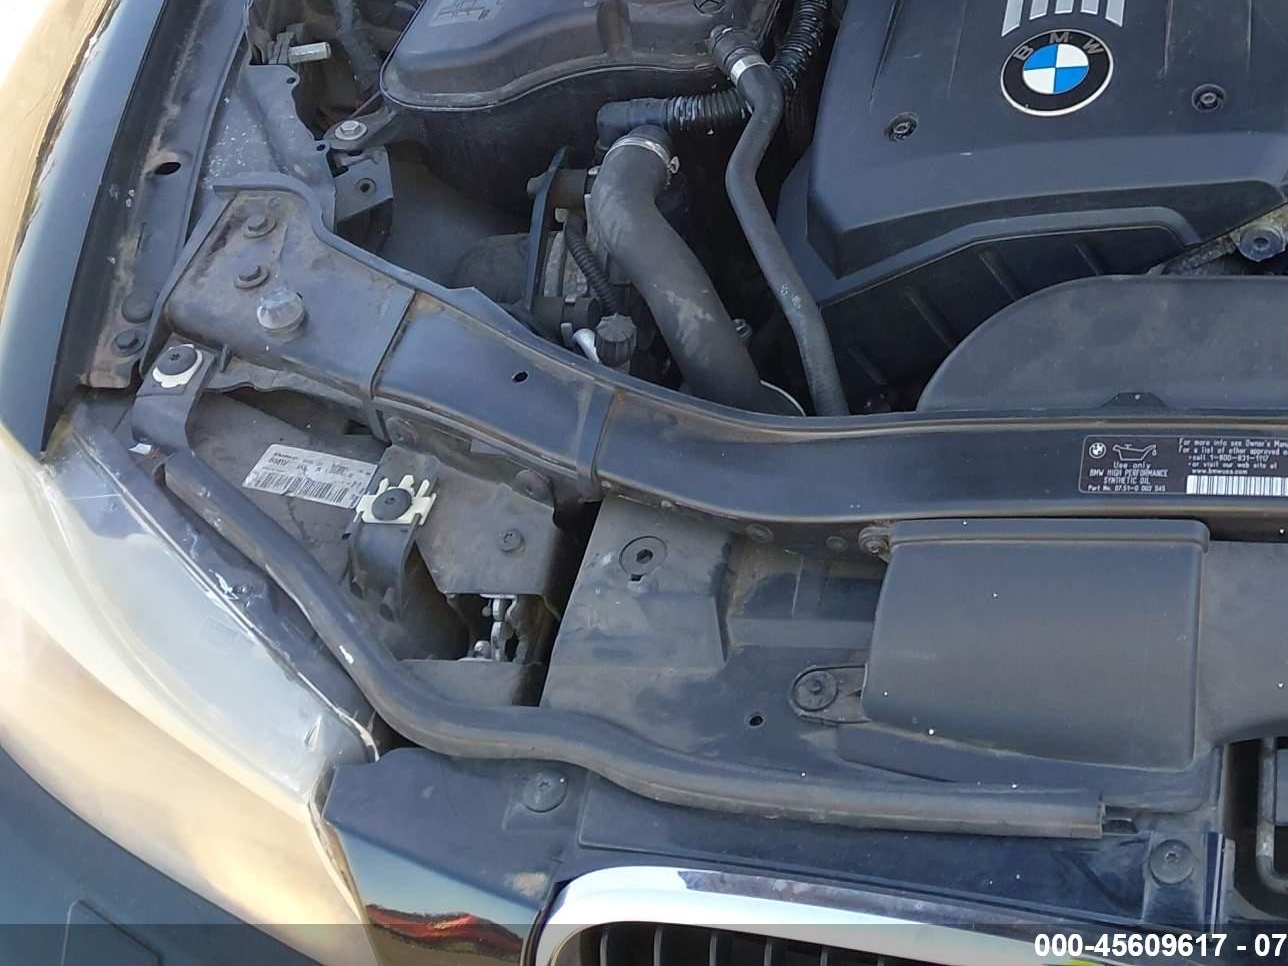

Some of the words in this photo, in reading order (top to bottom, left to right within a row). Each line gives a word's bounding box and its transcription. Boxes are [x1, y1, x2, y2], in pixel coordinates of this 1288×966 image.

[1013, 32, 1105, 61] BMW
[1179, 438, 1190, 446] For
[1246, 440, 1270, 448] Owner's
[1217, 446, 1225, 454] of
[1228, 446, 1247, 454] other
[1250, 447, 1280, 456] approved
[1133, 462, 1151, 470] only
[1125, 469, 1168, 477] PERFORMANCE
[1104, 476, 1137, 484] SYNTHETIC
